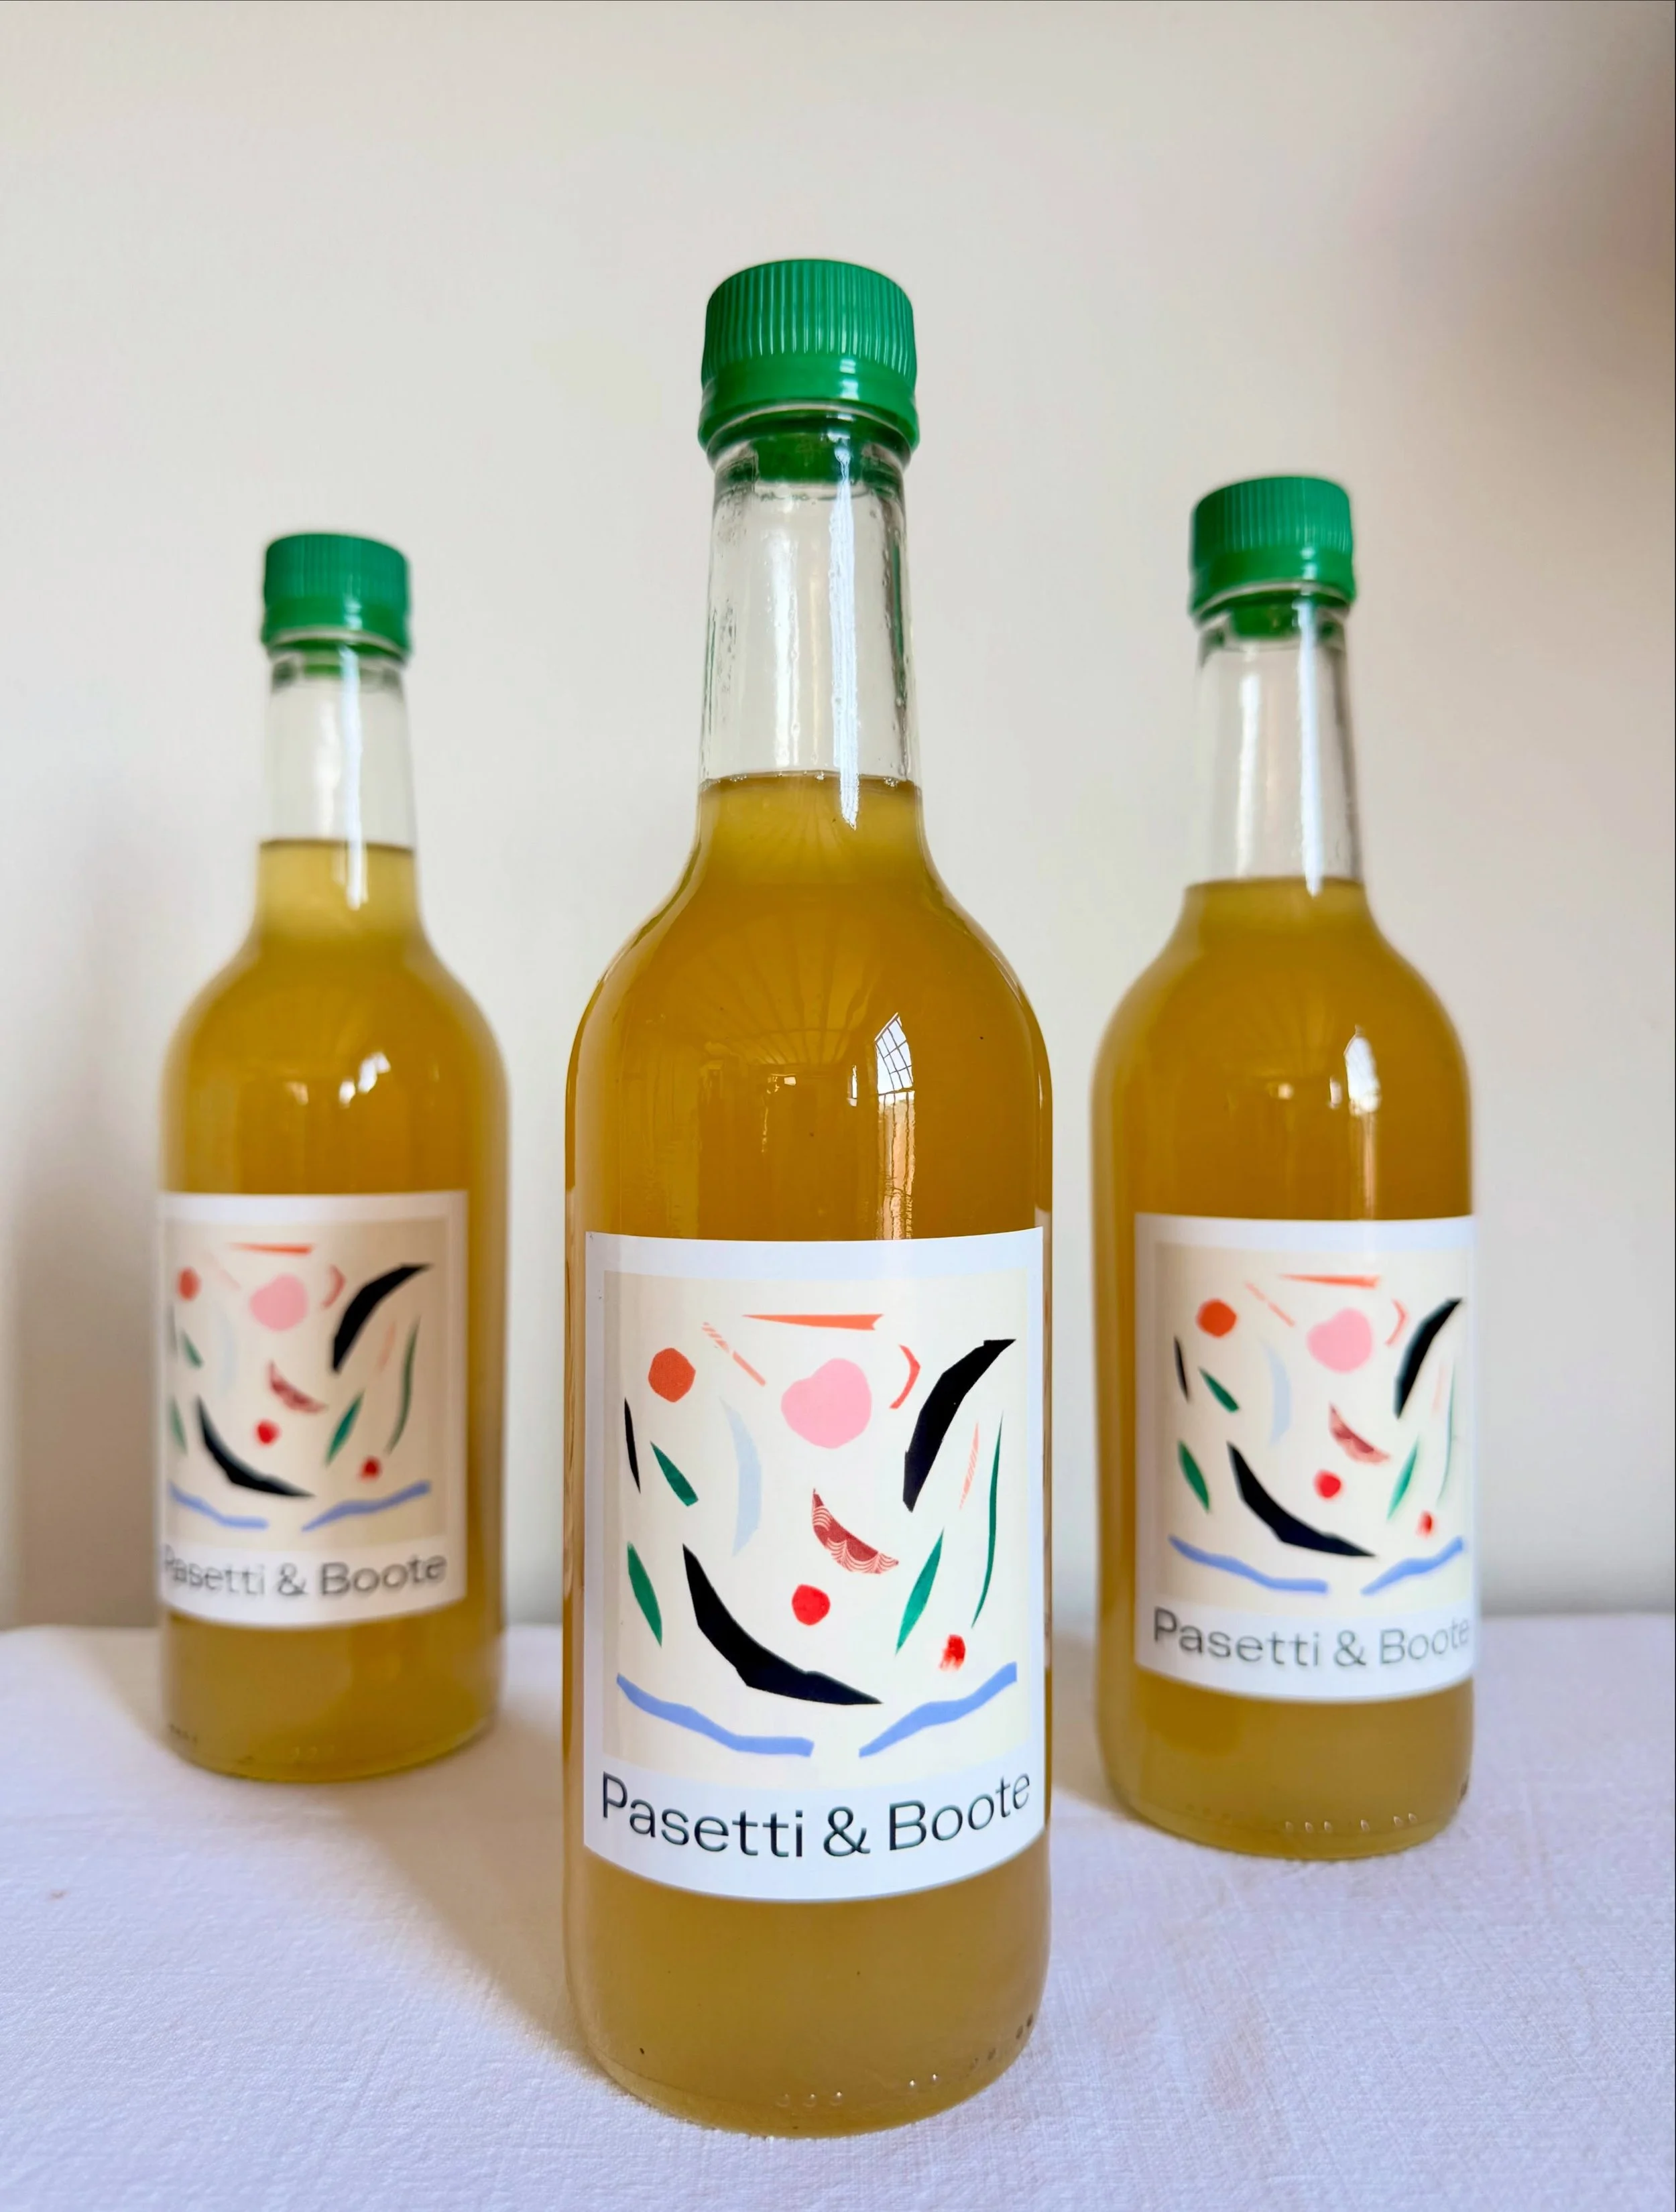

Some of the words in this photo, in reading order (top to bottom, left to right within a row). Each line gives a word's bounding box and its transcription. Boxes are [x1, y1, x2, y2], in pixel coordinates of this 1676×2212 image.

[163, 1542, 265, 1595] Pasetti
[276, 1561, 308, 1597] &
[320, 1553, 448, 1597] Boote
[1153, 1606, 1321, 1666] Pasetti
[1333, 1629, 1367, 1667] &
[1380, 1616, 1472, 1665] Boote
[602, 1771, 804, 1858] Pasetti
[822, 1806, 871, 1857] &
[888, 1772, 1031, 1851] Boote
